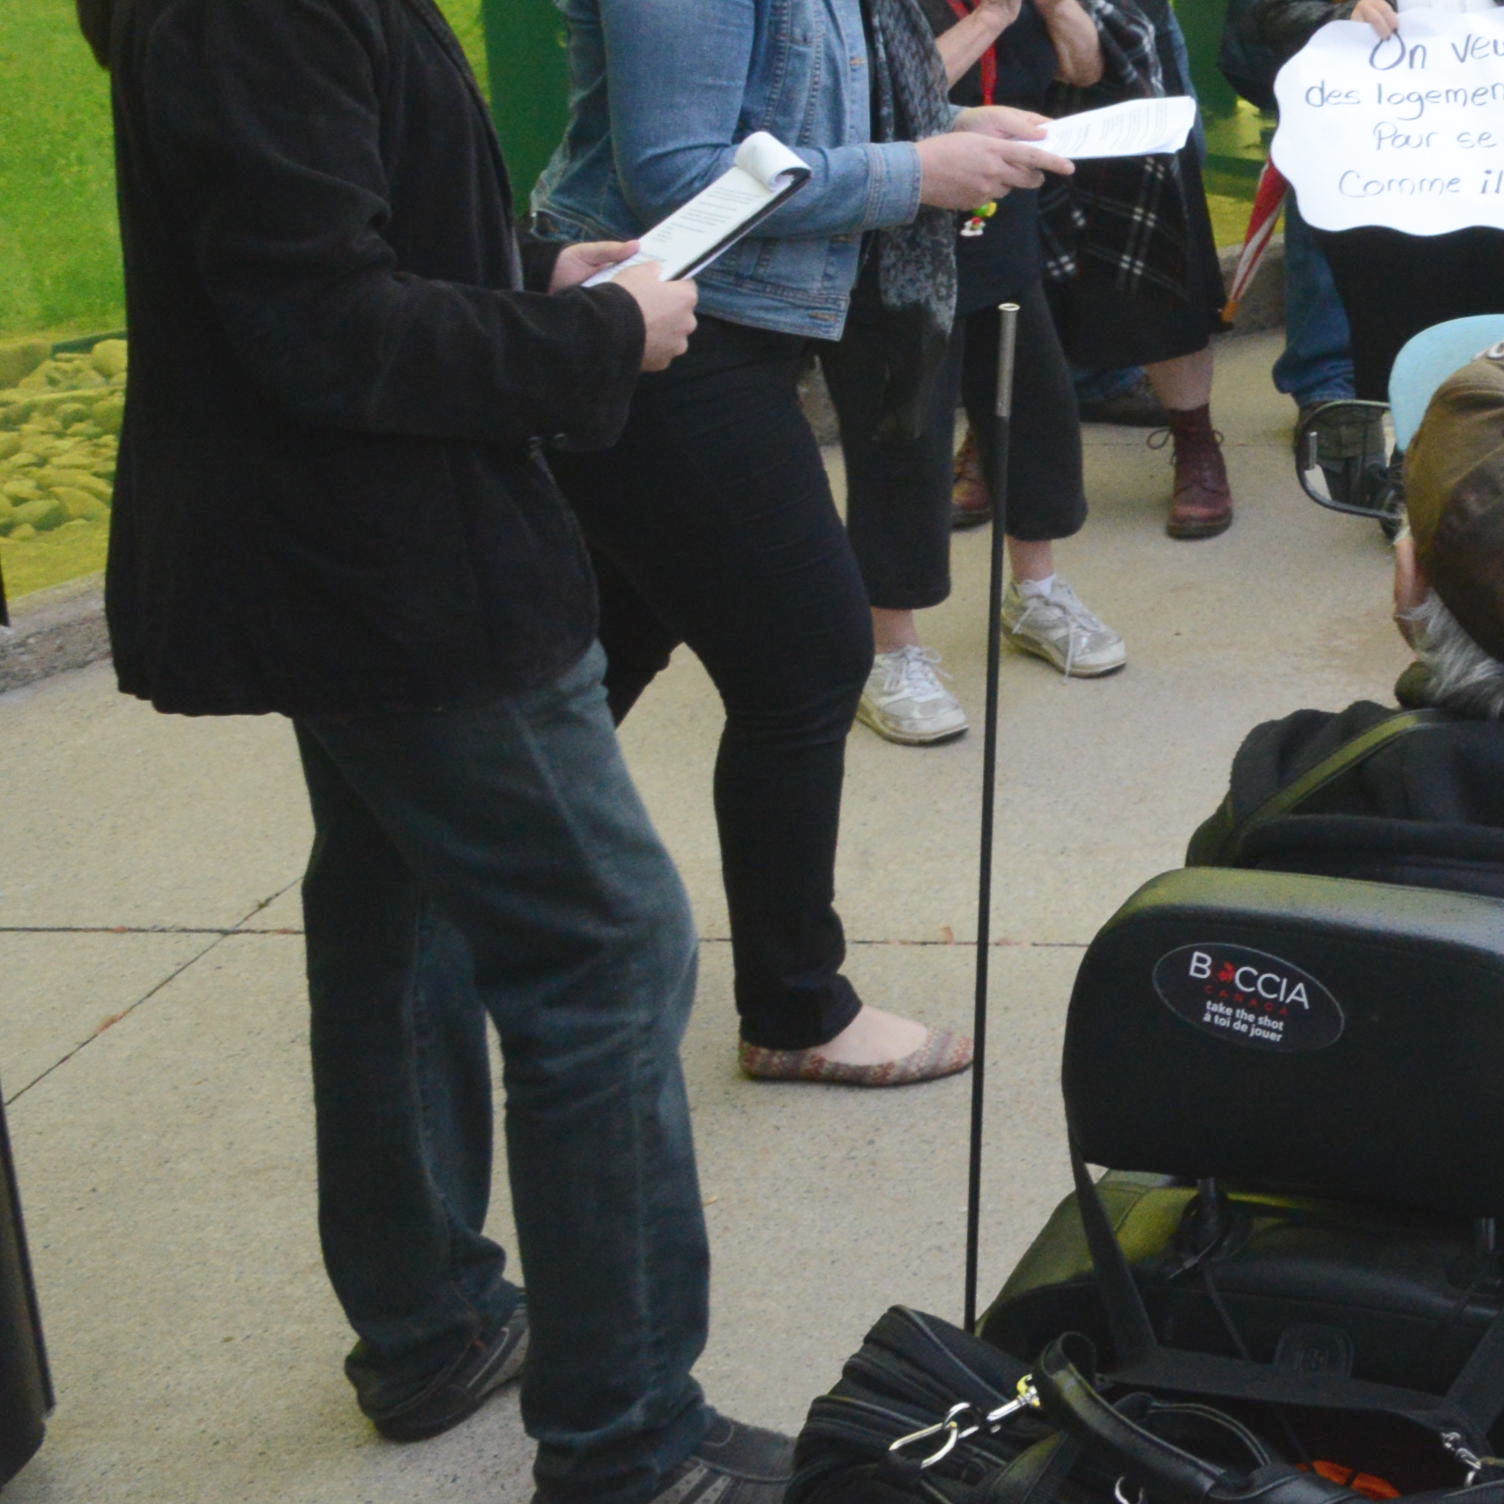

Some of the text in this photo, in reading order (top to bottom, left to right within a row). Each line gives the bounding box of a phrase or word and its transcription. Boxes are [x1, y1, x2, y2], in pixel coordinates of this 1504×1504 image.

[1370, 30, 1428, 71] On
[1305, 80, 1361, 108] des
[1373, 121, 1437, 152] Pour
[1456, 127, 1498, 150] se
[1479, 169, 1502, 195] il
[1202, 1011, 1283, 1043] à toi de jouer
[1205, 999, 1284, 1032] take the shot
